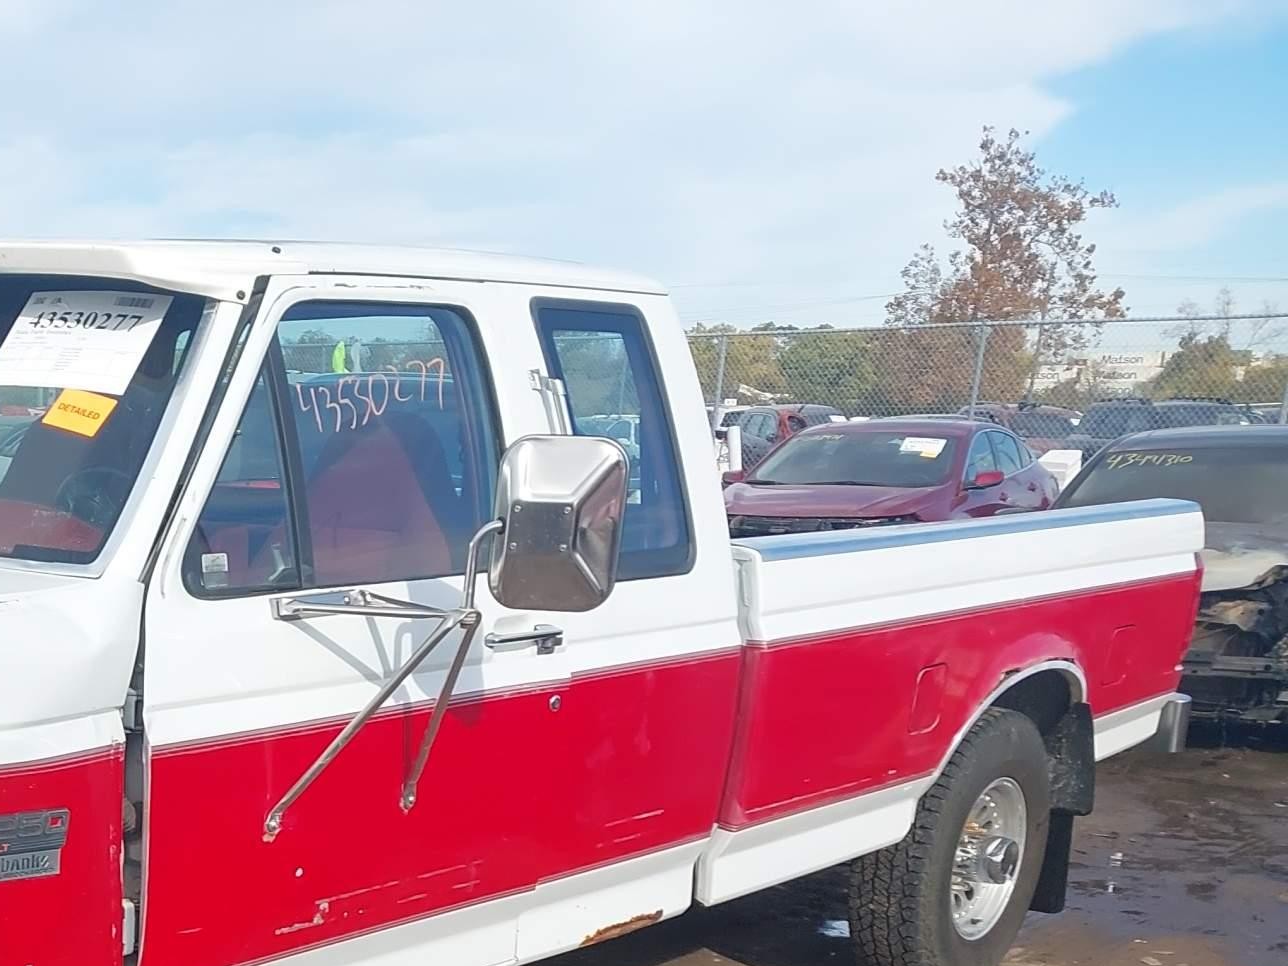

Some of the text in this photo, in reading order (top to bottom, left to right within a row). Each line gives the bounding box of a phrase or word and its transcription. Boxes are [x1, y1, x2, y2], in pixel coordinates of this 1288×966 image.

[29, 311, 144, 332] 43530277
[296, 357, 444, 433] 43530277
[57, 402, 101, 421] DETAILED
